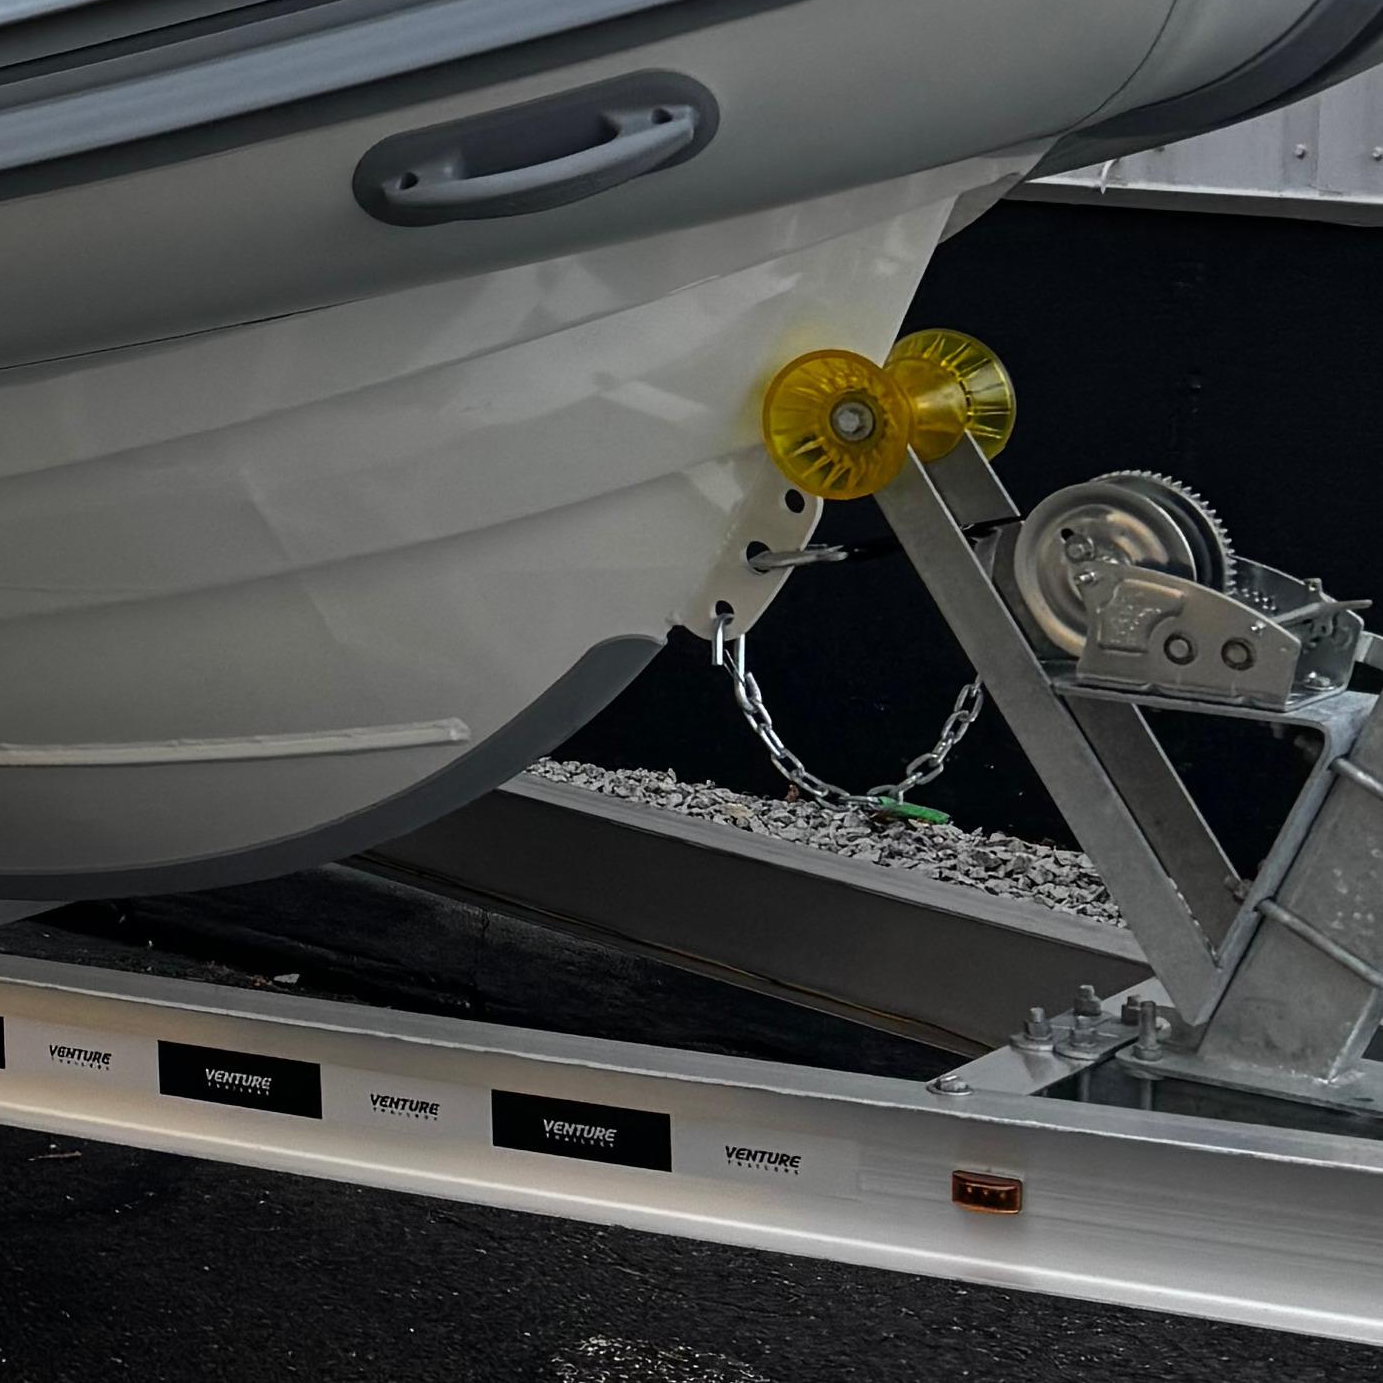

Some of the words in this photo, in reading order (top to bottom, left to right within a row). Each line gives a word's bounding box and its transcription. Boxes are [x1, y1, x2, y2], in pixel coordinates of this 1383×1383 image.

[49, 1044, 112, 1065] VENTURE
[205, 1068, 272, 1089] VENTURE
[370, 1093, 440, 1116] VENTURE
[543, 1119, 617, 1142] VENTURE
[725, 1145, 802, 1168] VENTURE
